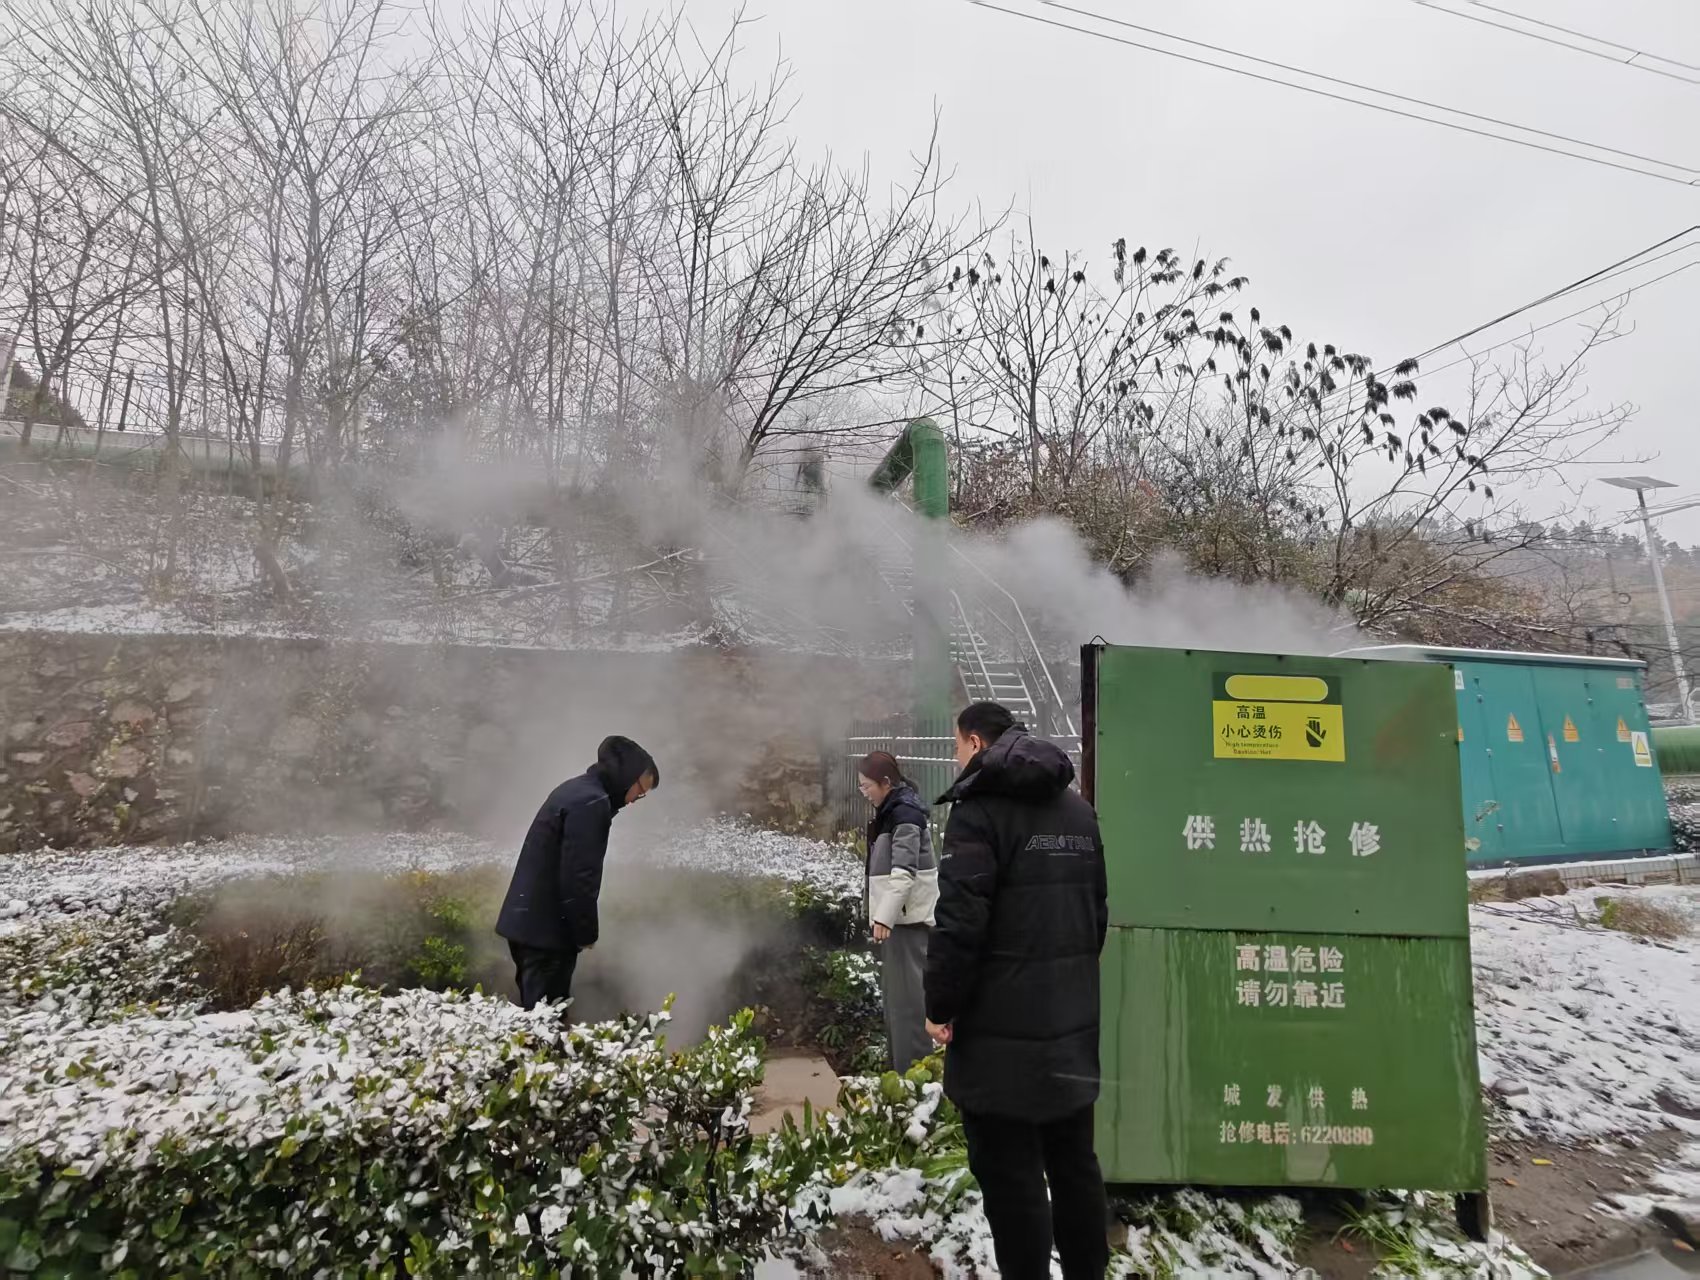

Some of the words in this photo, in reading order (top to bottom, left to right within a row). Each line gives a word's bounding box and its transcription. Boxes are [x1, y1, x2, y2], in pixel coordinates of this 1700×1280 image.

[1236, 705, 1266, 719] 高温
[1222, 724, 1282, 739] 小心烫伤
[1182, 815, 1381, 857] 供热抢修
[1236, 943, 1344, 973] 高温危险
[1236, 979, 1345, 1008] 请勿靠近
[1223, 1083, 1368, 1110] 城发供热
